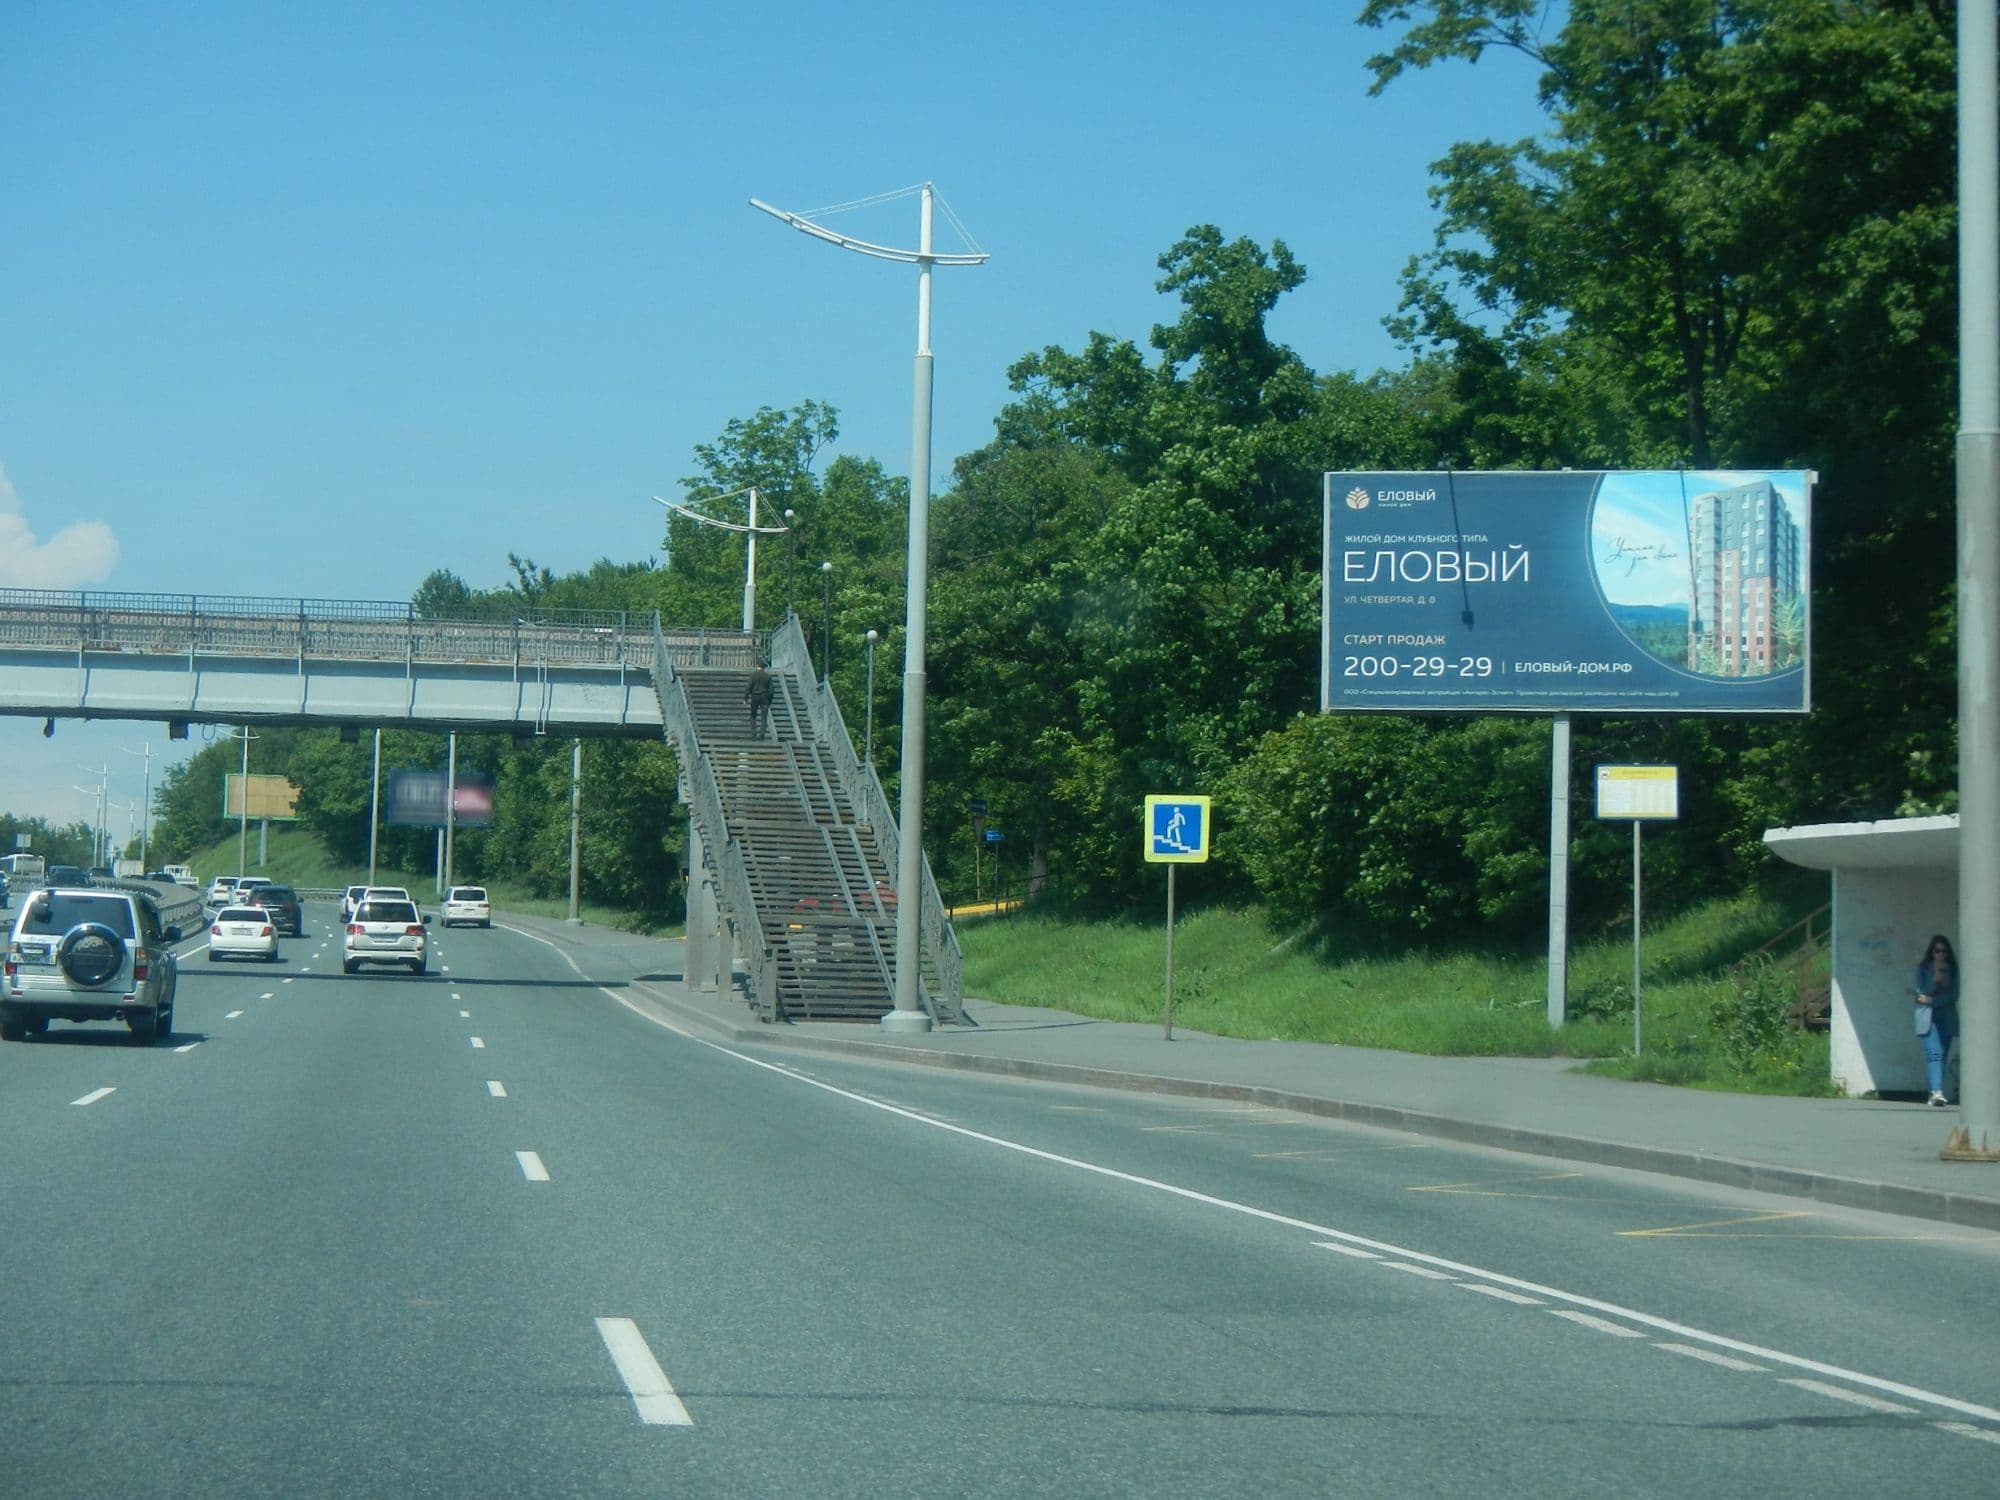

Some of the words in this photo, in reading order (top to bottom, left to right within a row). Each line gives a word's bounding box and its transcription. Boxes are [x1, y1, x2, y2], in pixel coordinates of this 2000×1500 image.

[1377, 488, 1436, 502] ЕЛОВЫЙ
[1344, 533, 1382, 544] ЖИЛОЙ
[1383, 534, 1406, 544] ДОМ
[1407, 534, 1459, 544] КЛУБНОГО
[1462, 534, 1489, 544] ТИПА
[1343, 543, 1530, 583] ЕЛОВЫЙ
[1343, 634, 1384, 645] СТАРТ
[1387, 634, 1446, 647] ПРОДАЖ
[1343, 655, 1493, 677] 200-29-29
[1514, 660, 1633, 674] ЕЛОВЫЙ-ДОМ.РФ
